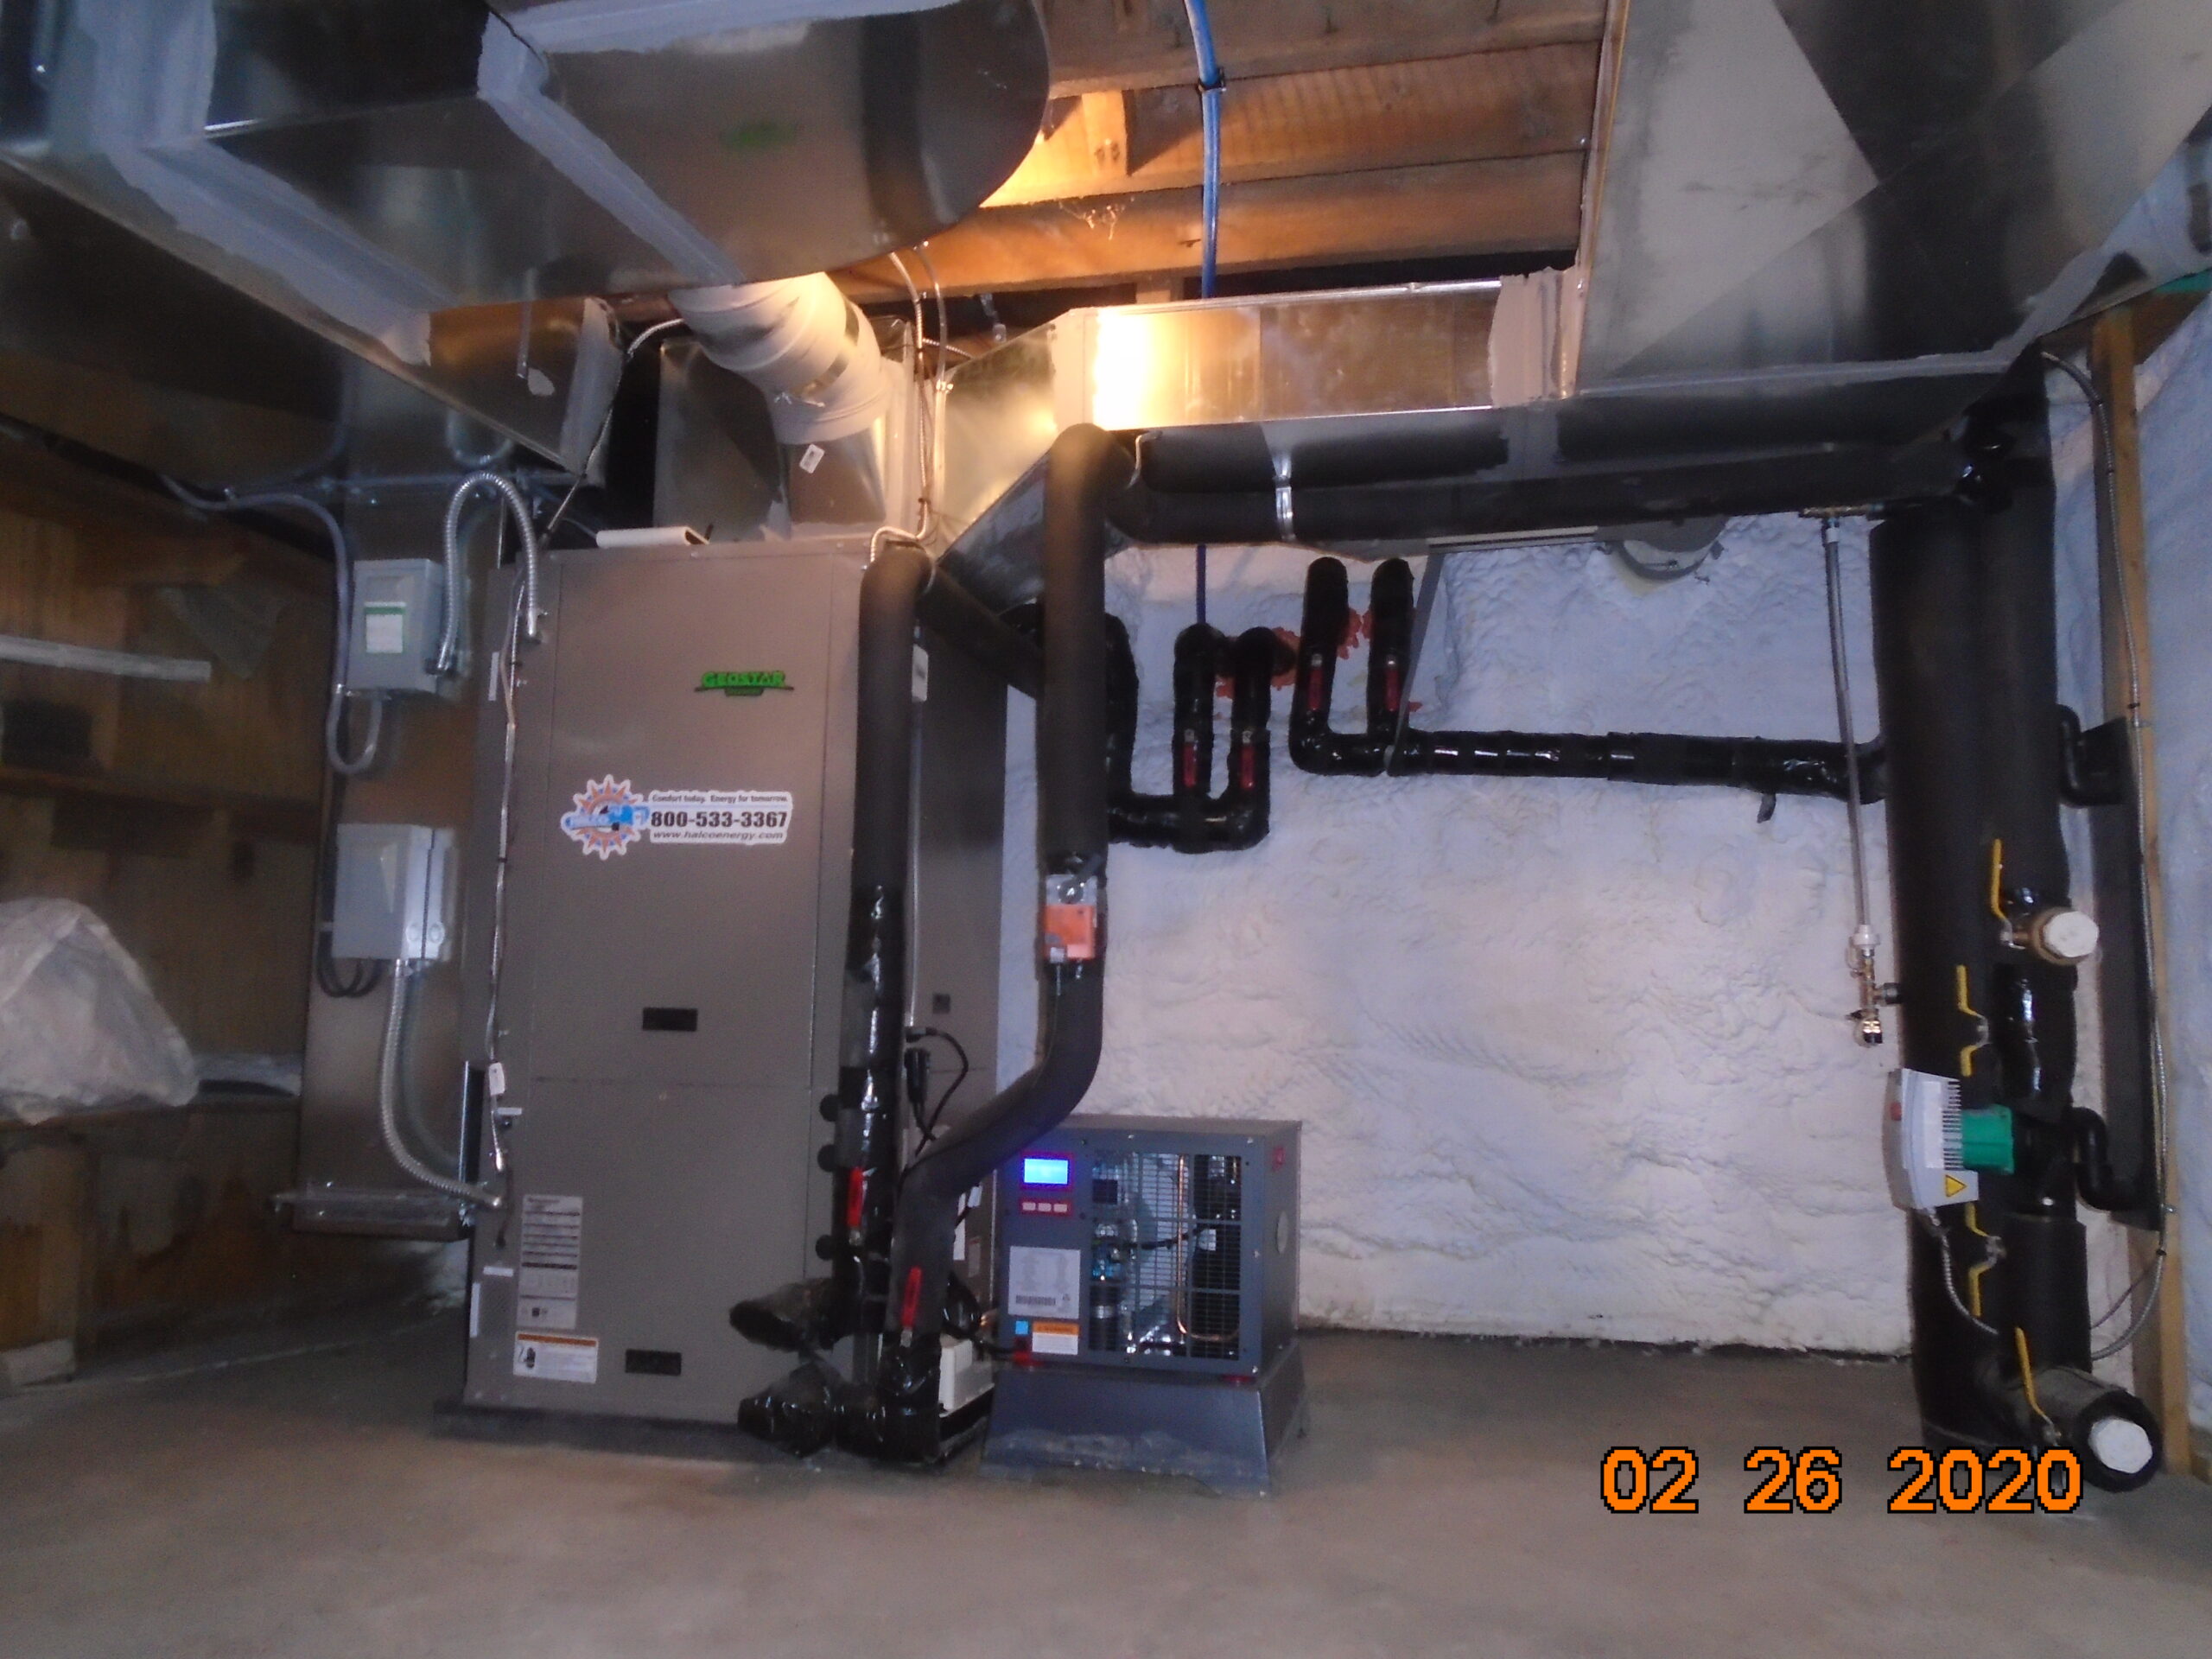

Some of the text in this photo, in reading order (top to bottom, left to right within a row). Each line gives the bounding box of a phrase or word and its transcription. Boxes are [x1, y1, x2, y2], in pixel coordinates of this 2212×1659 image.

[702, 671, 785, 688] GEOSTAR
[652, 794, 682, 803] Comfort
[710, 794, 736, 804] Energy
[738, 794, 748, 803] for
[651, 810, 788, 828] 800-533-3367
[653, 830, 784, 840] www.halcoenergy.com
